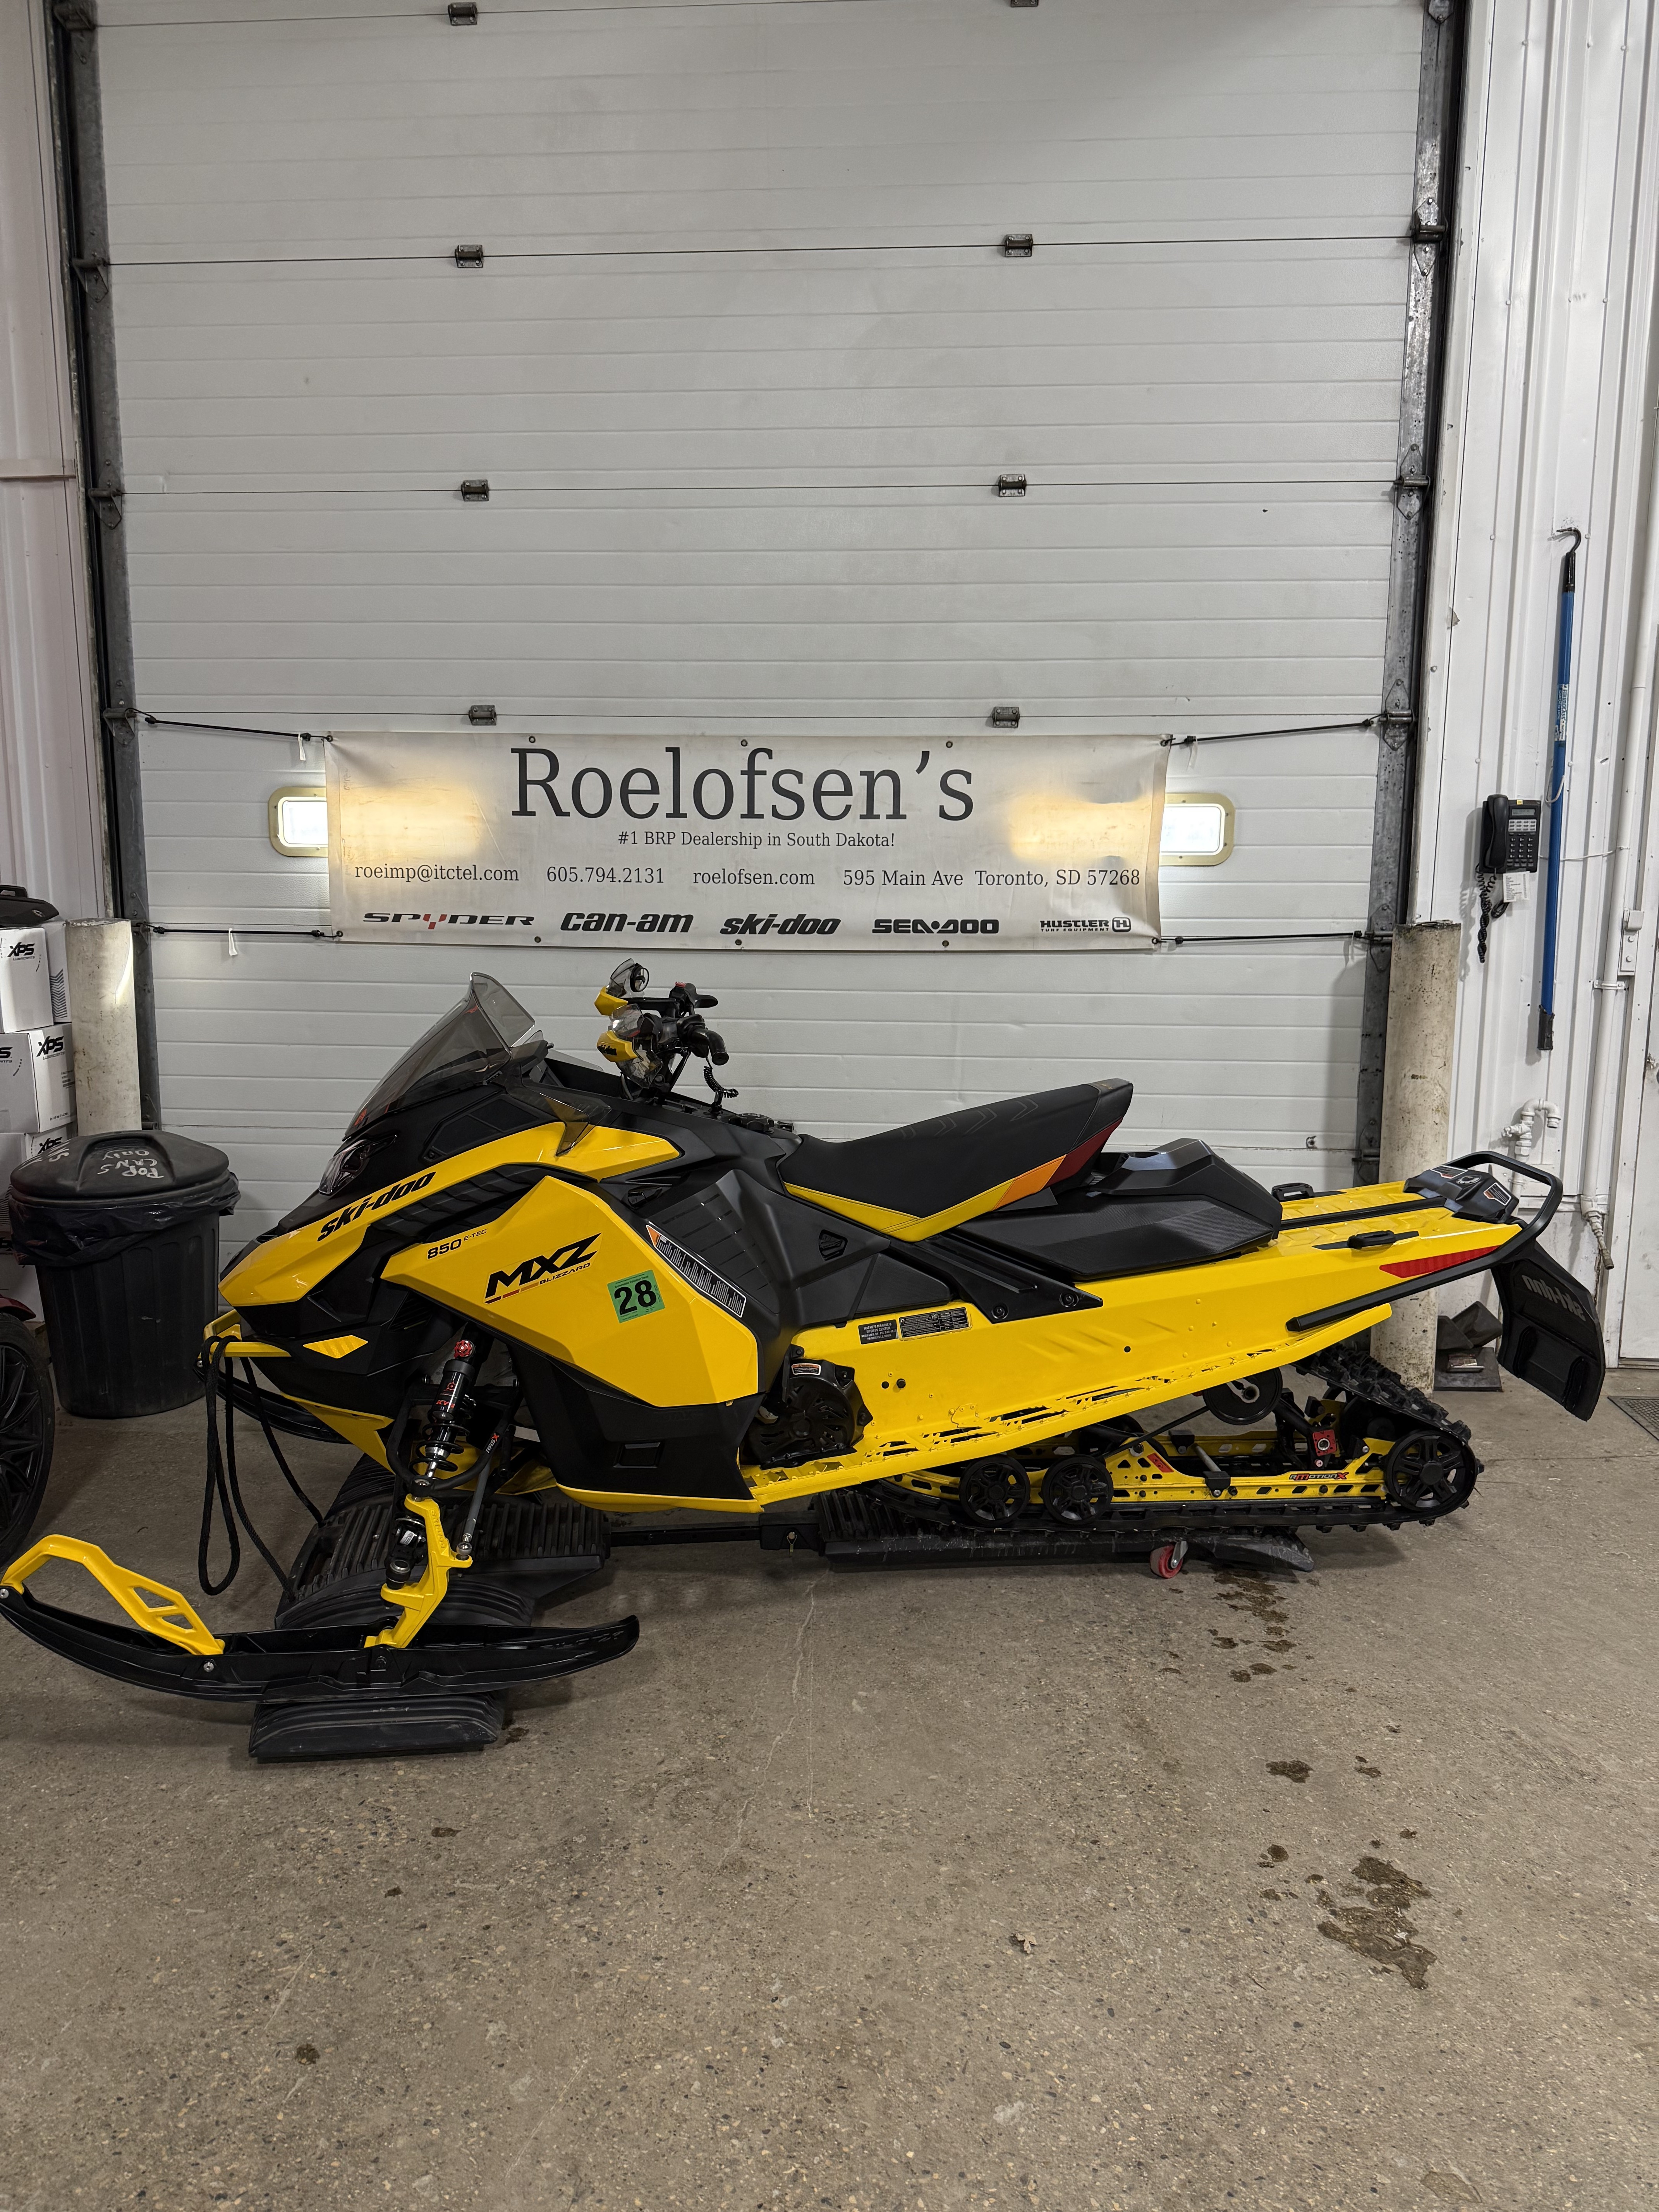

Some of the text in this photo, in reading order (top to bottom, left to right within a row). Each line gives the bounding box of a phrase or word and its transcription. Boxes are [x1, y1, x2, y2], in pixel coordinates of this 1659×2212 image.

[510, 747, 974, 820] Roelofsen's
[618, 831, 895, 849] #1 BRP Dealership in South Dakota!
[355, 863, 520, 883] roeimp@itctel.com
[547, 866, 665, 883] 605.794.2131
[693, 868, 816, 885] roelofsen.com
[843, 869, 1140, 888] 595 Main Ave Toronto, SD 57268
[363, 913, 535, 930] SPYDER
[560, 912, 694, 933] can-am
[719, 914, 842, 935] ski-doo
[7, 942, 35, 957] XPS
[36, 1036, 64, 1057] XPS
[121, 1165, 164, 1178] POP
[318, 1171, 436, 1241] ski-doo
[427, 1228, 487, 1259] 850 E-TEC
[485, 1232, 602, 1299] MXZ
[539, 1262, 591, 1285] BLIZZARD
[614, 1280, 657, 1315] 28
